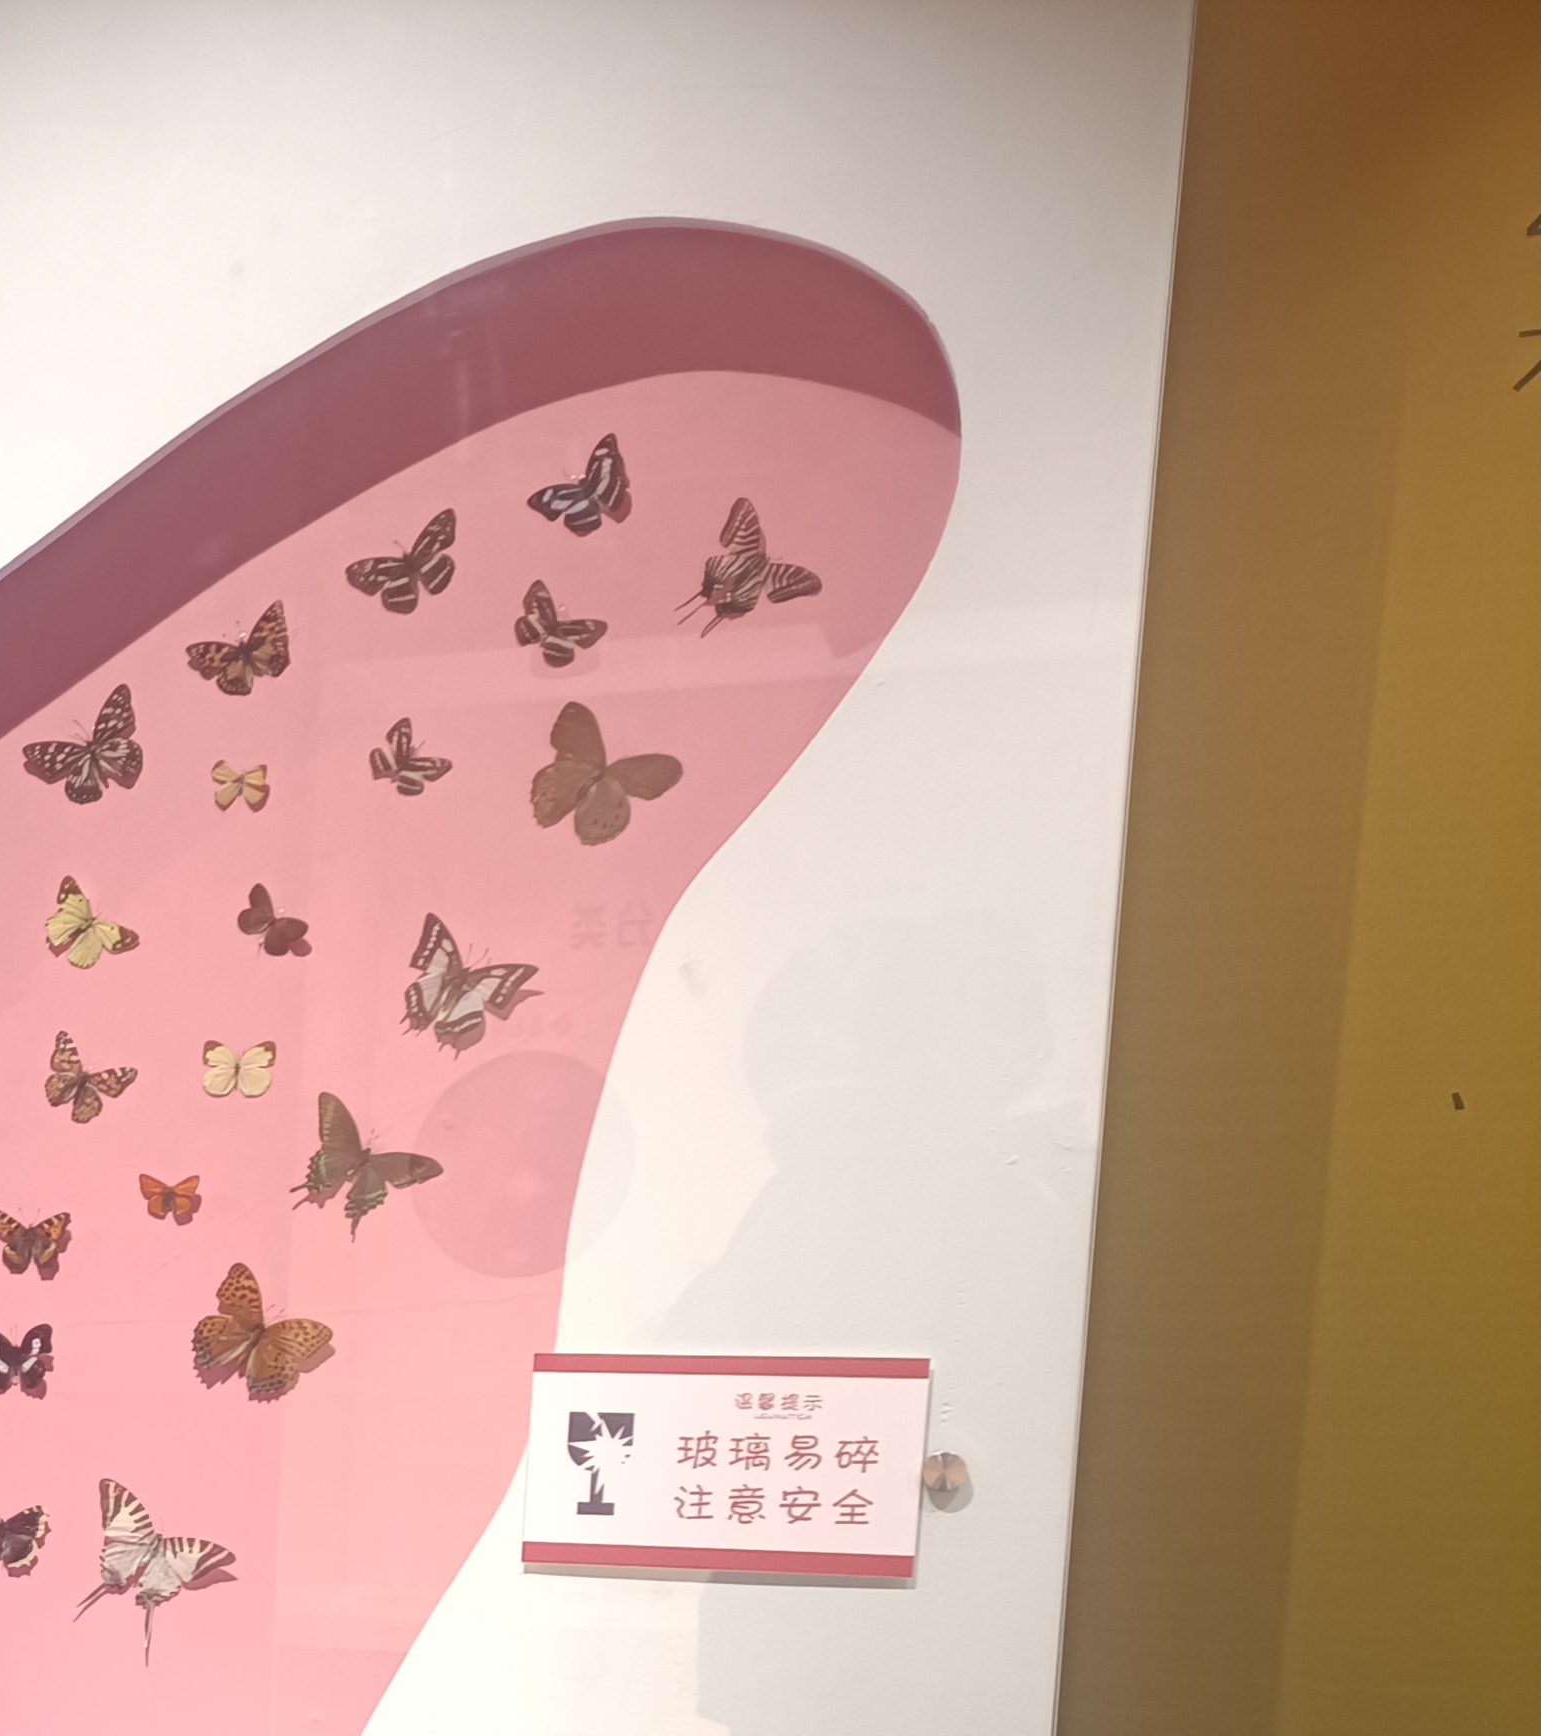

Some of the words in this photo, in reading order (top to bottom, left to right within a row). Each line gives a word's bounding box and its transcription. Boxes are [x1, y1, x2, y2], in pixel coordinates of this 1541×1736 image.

[676, 1430, 880, 1473] 玻璃易碎
[674, 1485, 874, 1525] 注意安全
